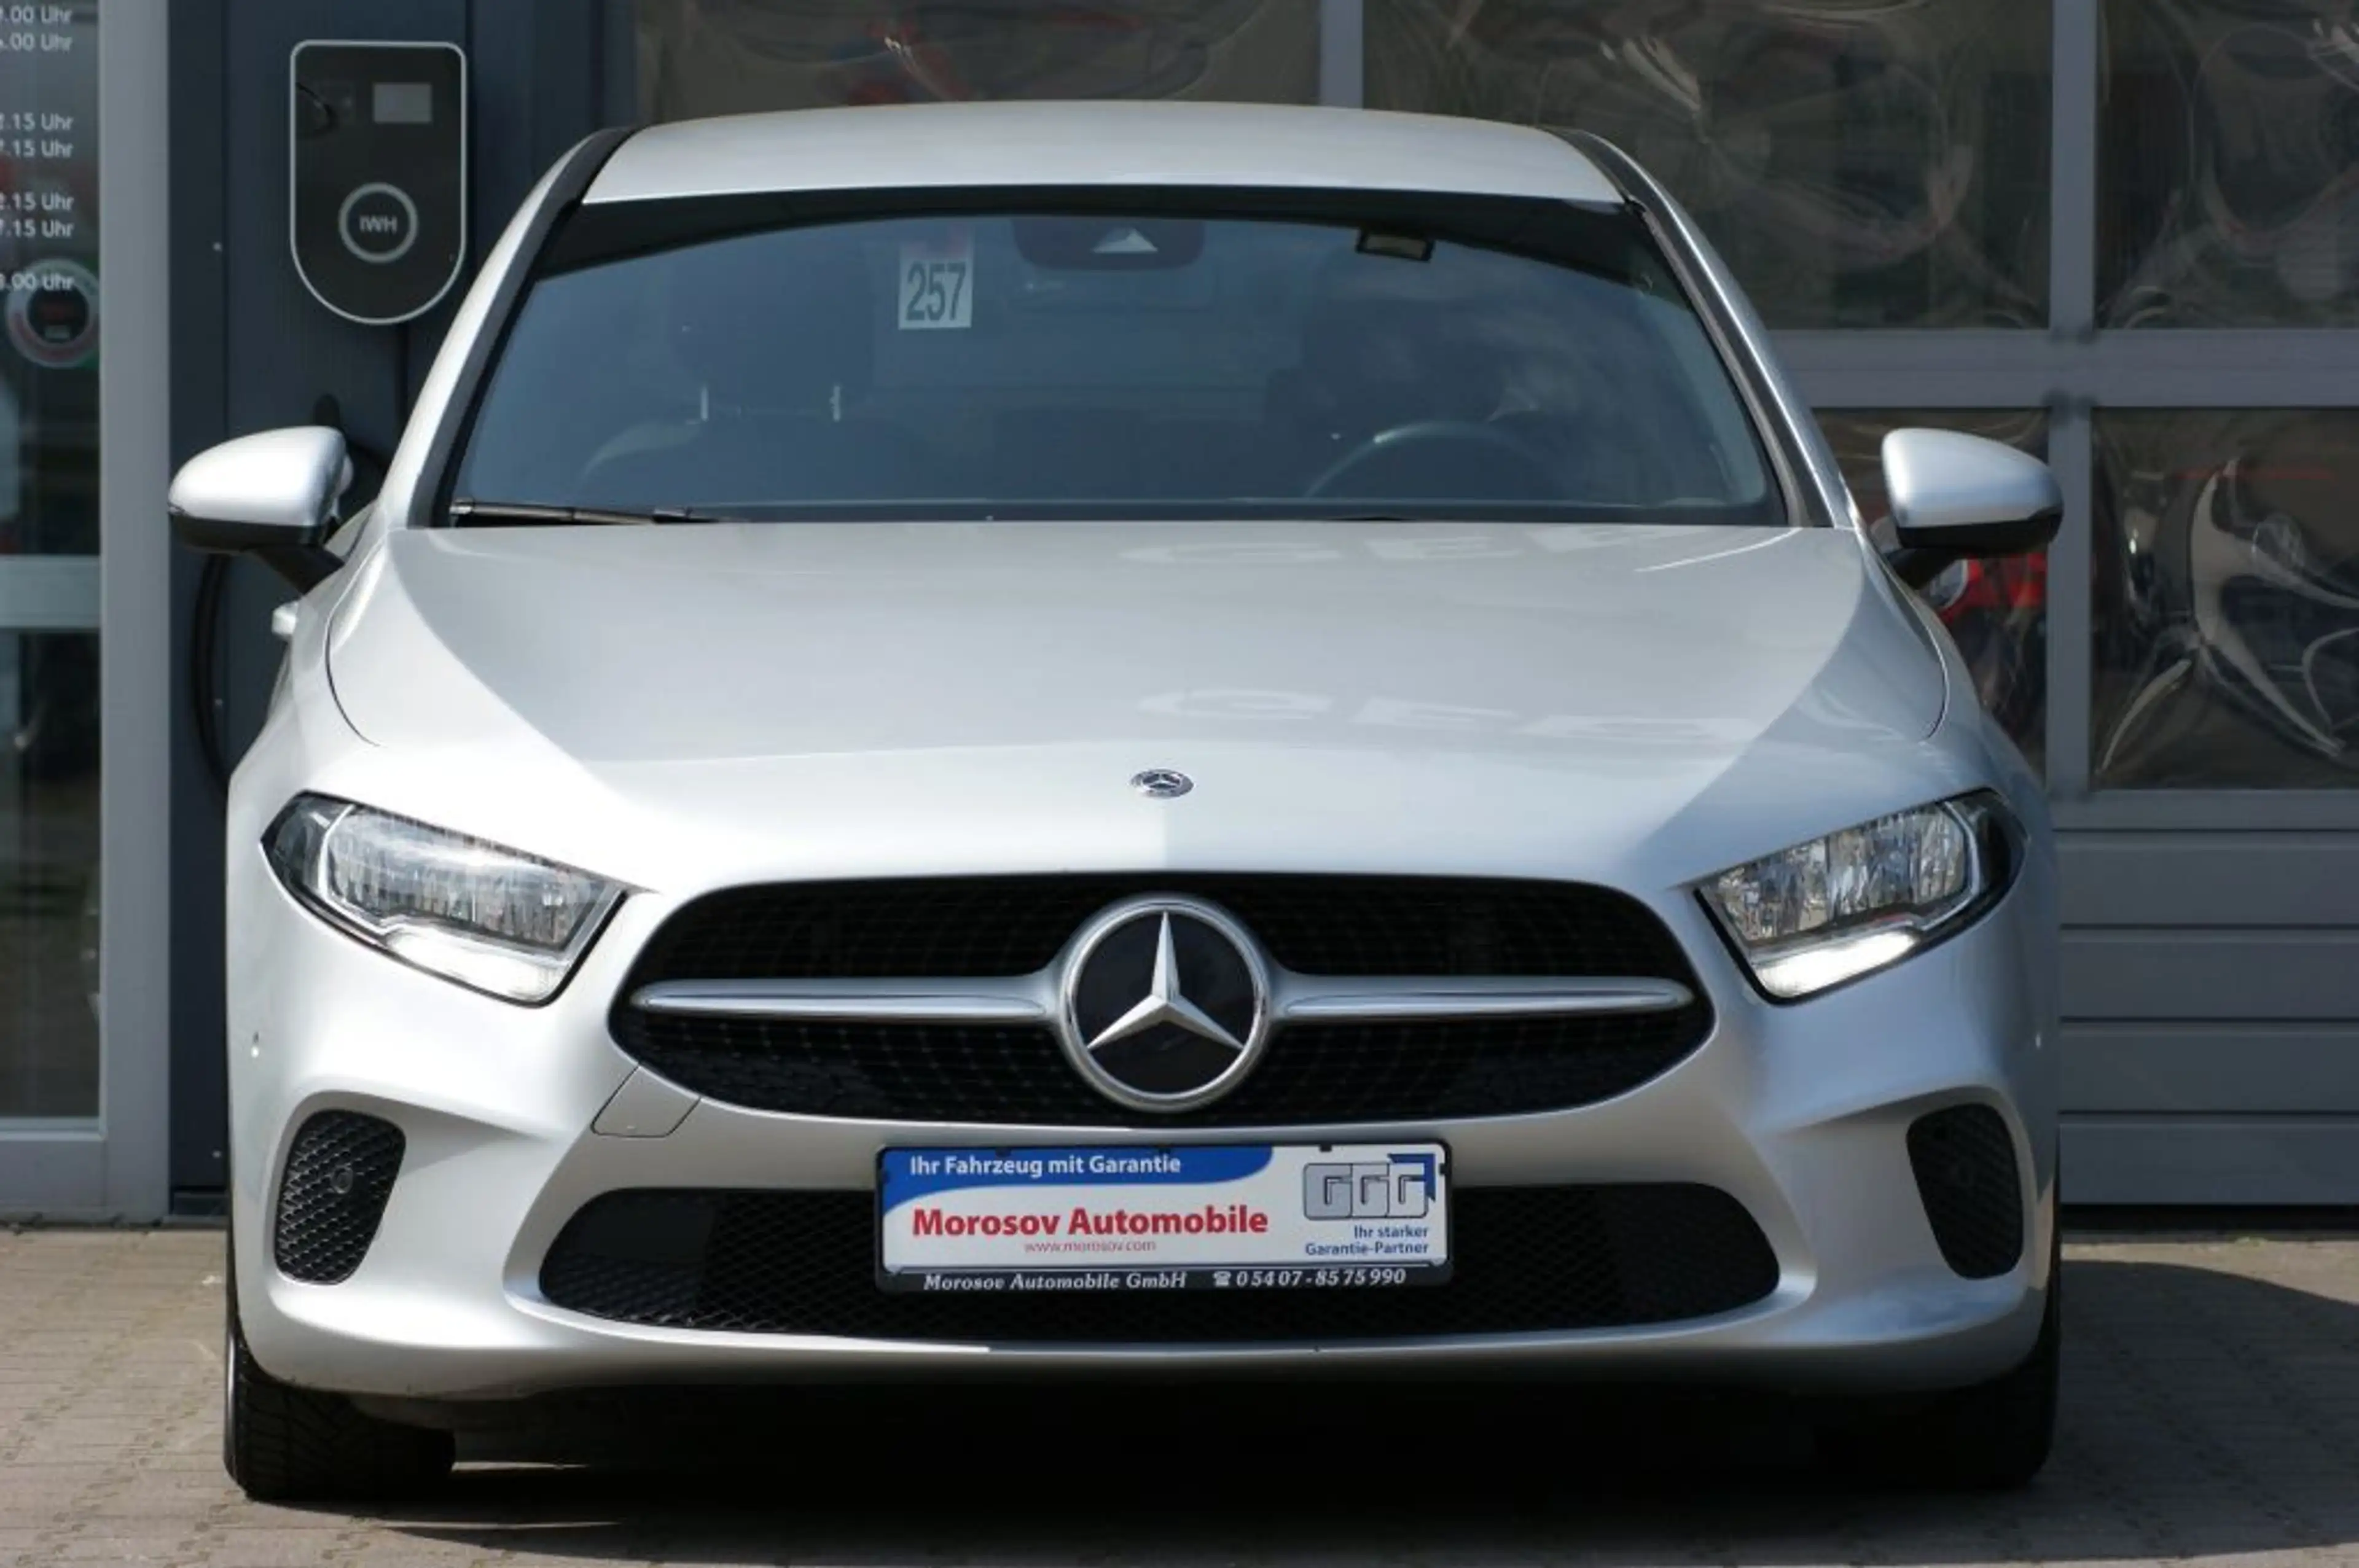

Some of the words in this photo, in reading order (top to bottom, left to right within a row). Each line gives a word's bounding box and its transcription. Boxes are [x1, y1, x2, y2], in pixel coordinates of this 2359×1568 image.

[0, 6, 34, 24] .00
[41, 5, 72, 25] Uhr
[0, 33, 34, 51] .00
[41, 33, 72, 52] Uhr
[41, 112, 73, 131] Uhr
[41, 139, 73, 158] Uhr
[41, 192, 74, 211] Uhr
[41, 219, 74, 238] Uhr
[359, 214, 397, 233] IWH
[42, 272, 74, 290] Uhr
[906, 261, 966, 322] 257
[910, 1155, 940, 1175] Ihr
[945, 1155, 1043, 1178] Fahrzeug
[1047, 1155, 1084, 1174] mit
[1089, 1155, 1181, 1174] Garantie
[913, 1207, 1060, 1236] Morosov
[1068, 1204, 1269, 1236] Automobile
[1353, 1225, 1374, 1239] Ihr
[1377, 1224, 1429, 1239] starker
[1024, 1240, 1156, 1254] www.morosov.com
[1305, 1241, 1430, 1256] Garantie-Partner
[923, 1273, 1005, 1290] Morosov
[1010, 1272, 1120, 1290] Automobile
[1126, 1271, 1187, 1289] GmbH
